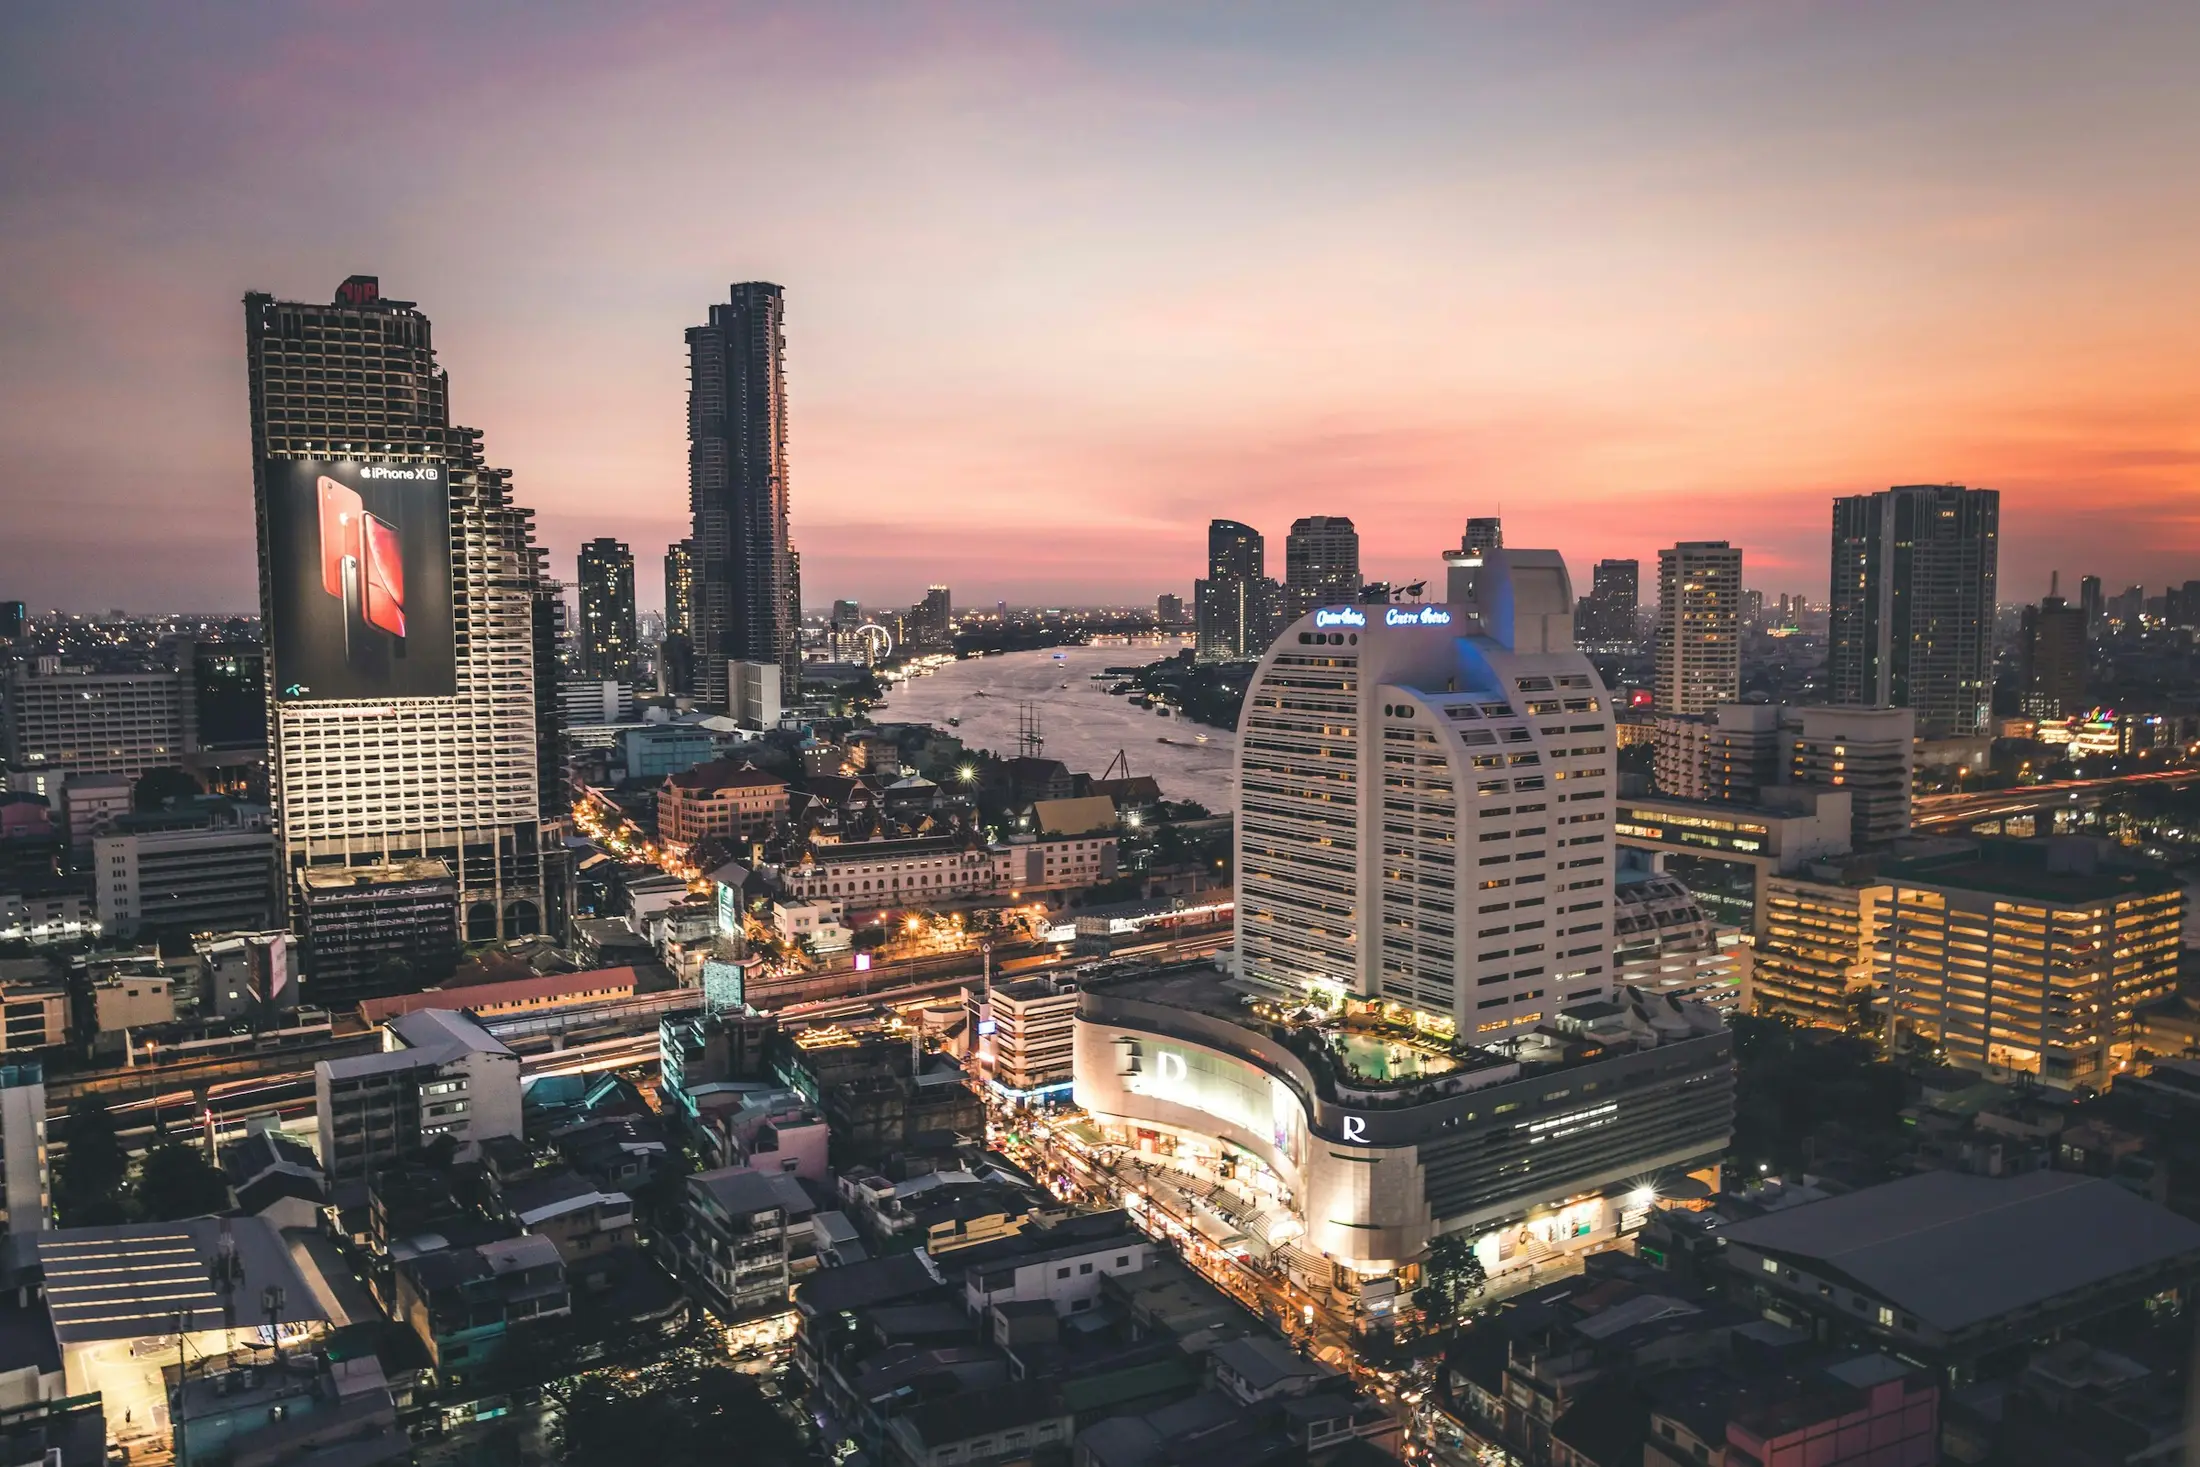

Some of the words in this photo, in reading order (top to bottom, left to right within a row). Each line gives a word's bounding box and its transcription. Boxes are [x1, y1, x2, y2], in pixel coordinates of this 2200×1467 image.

[371, 467, 415, 480] iPhone
[1386, 608, 1418, 626] Centre
[1343, 1115, 1371, 1143] R
